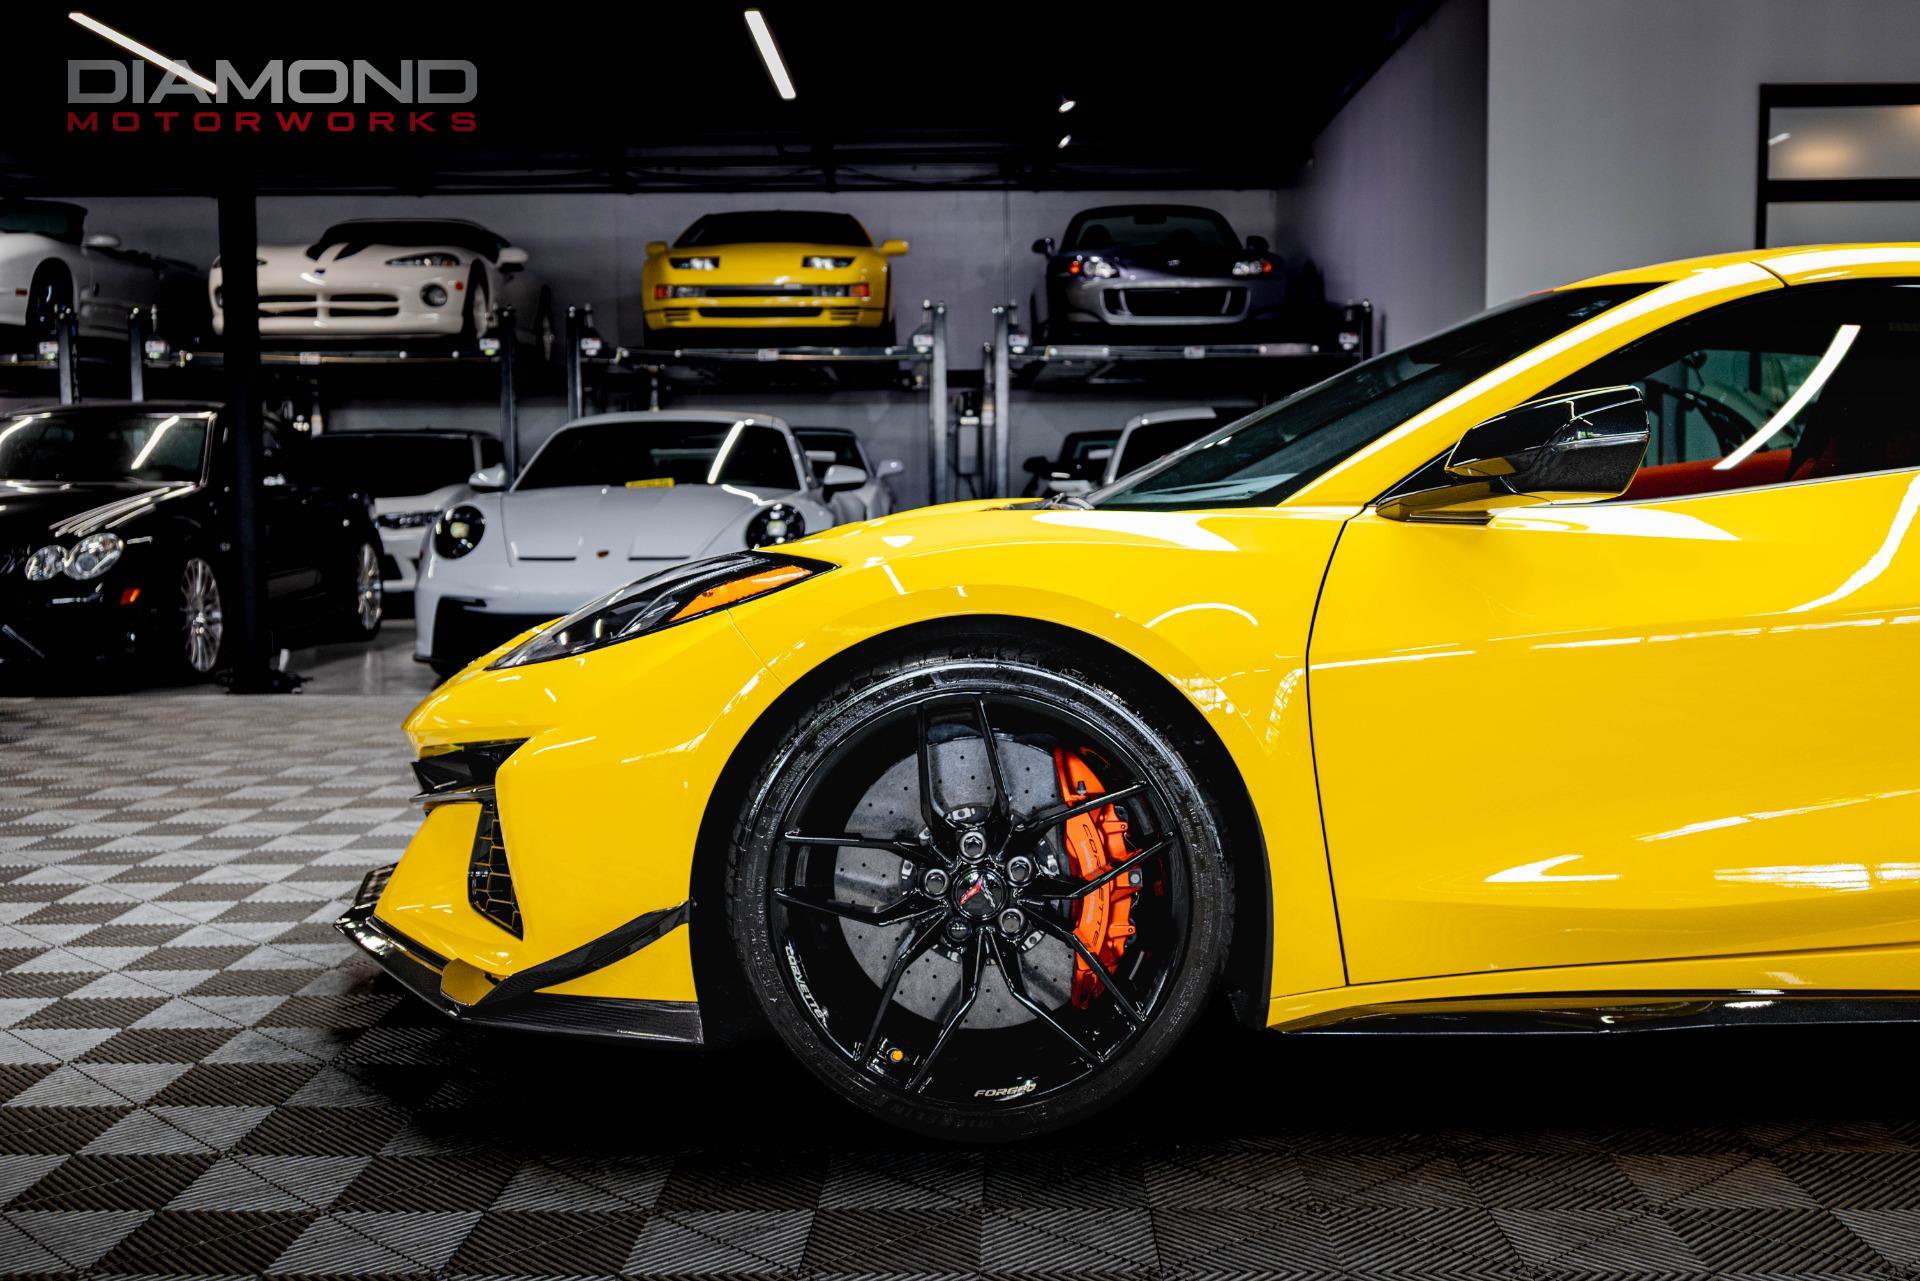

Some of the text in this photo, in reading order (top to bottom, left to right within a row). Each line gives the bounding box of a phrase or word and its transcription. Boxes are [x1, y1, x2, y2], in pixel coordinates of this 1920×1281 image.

[1083, 824, 1104, 947] CORETTE
[785, 945, 825, 1019] CORVETTE
[974, 1082, 1037, 1098] FORGED
